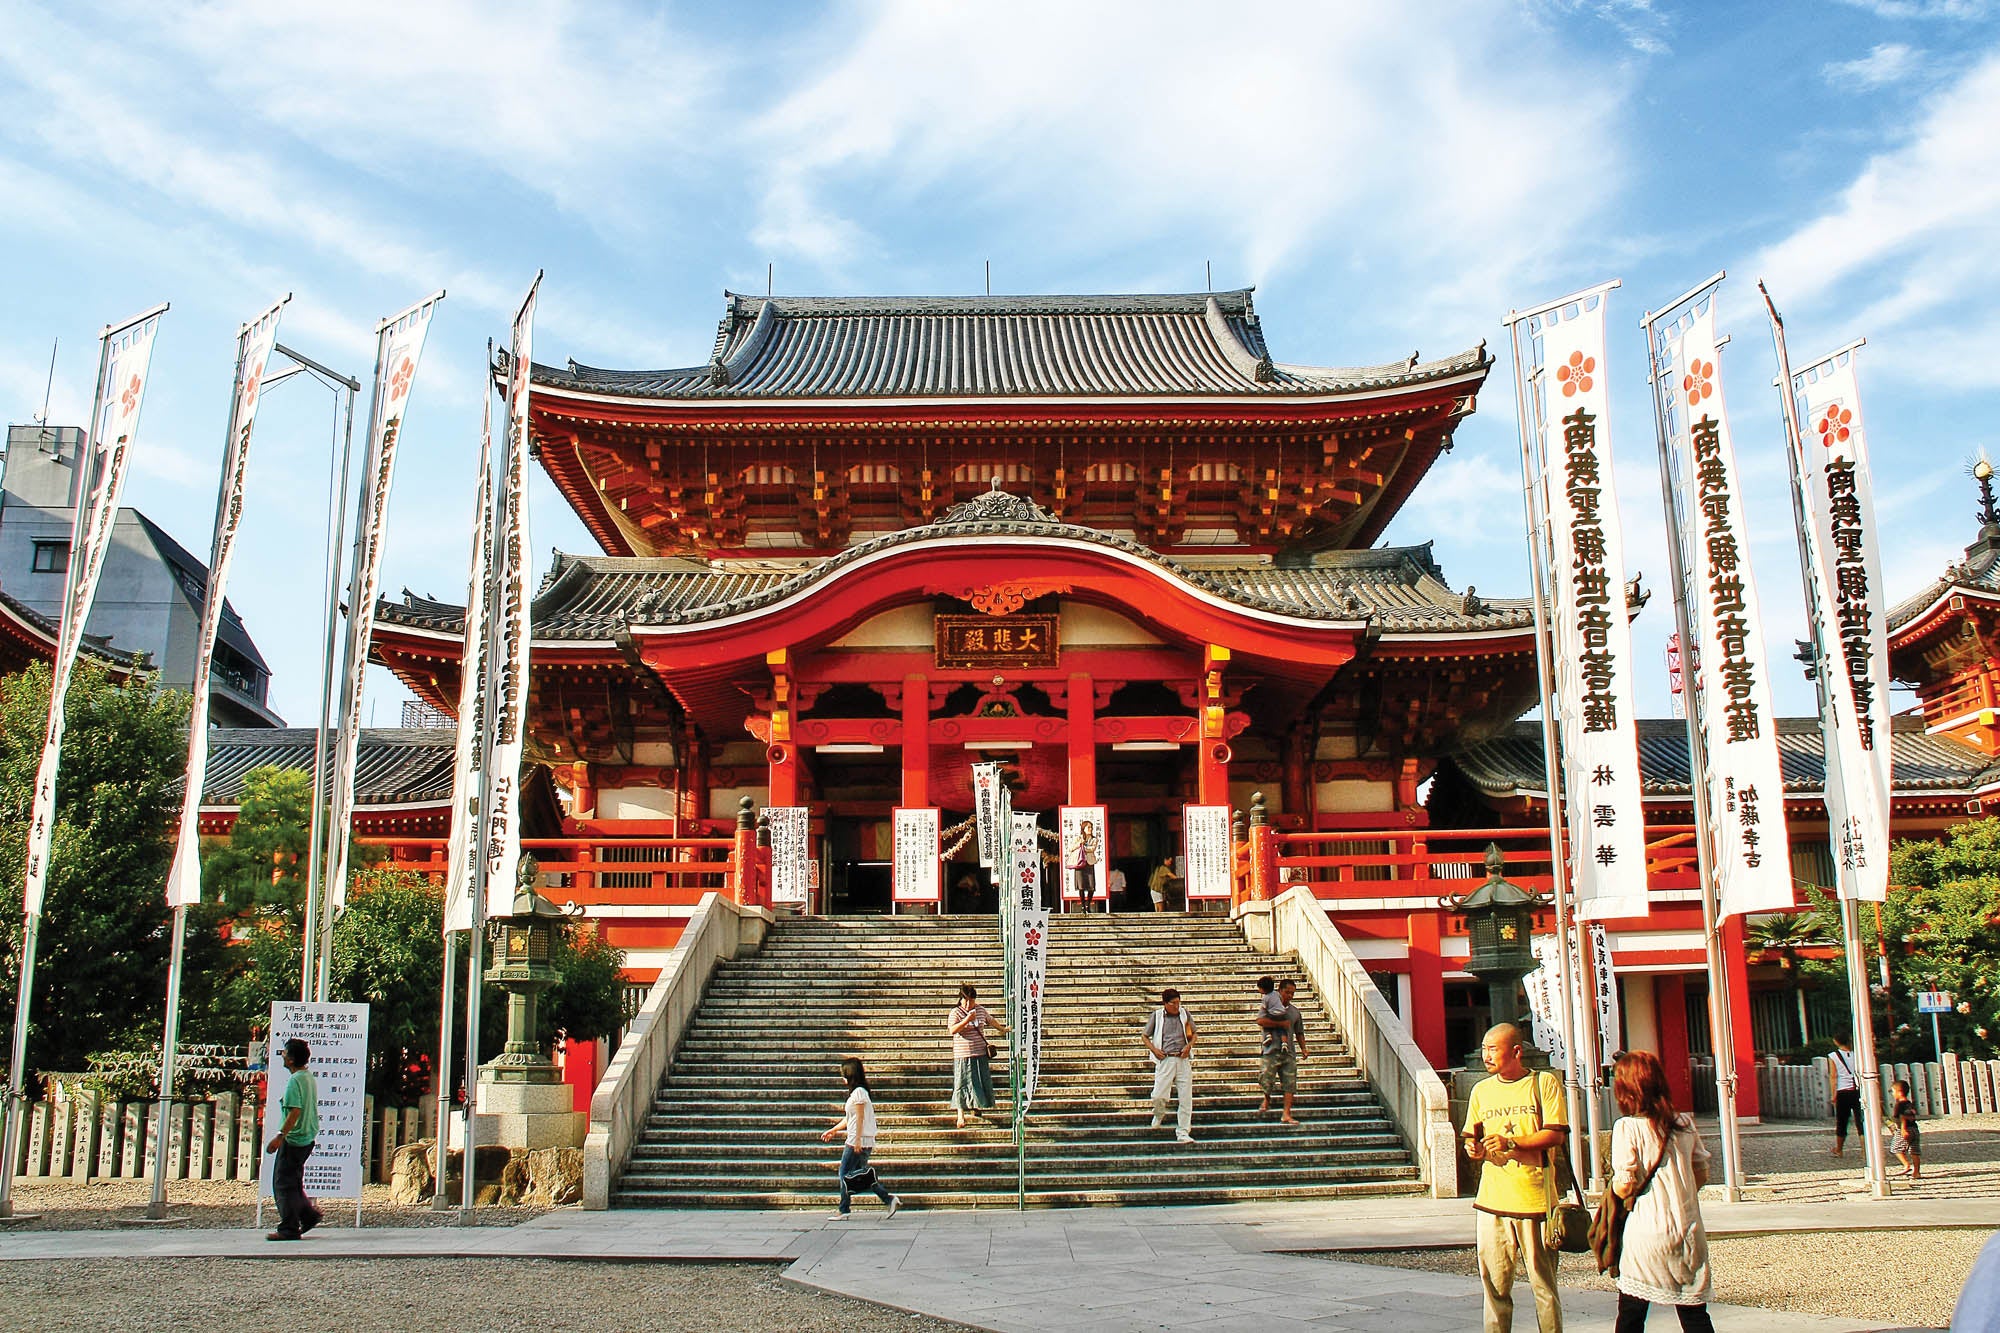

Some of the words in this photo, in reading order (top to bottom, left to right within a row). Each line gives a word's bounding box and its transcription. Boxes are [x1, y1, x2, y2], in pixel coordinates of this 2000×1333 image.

[282, 1013, 359, 1023] 人形供養祭次第
[1480, 1105, 1536, 1121] CONVERS
